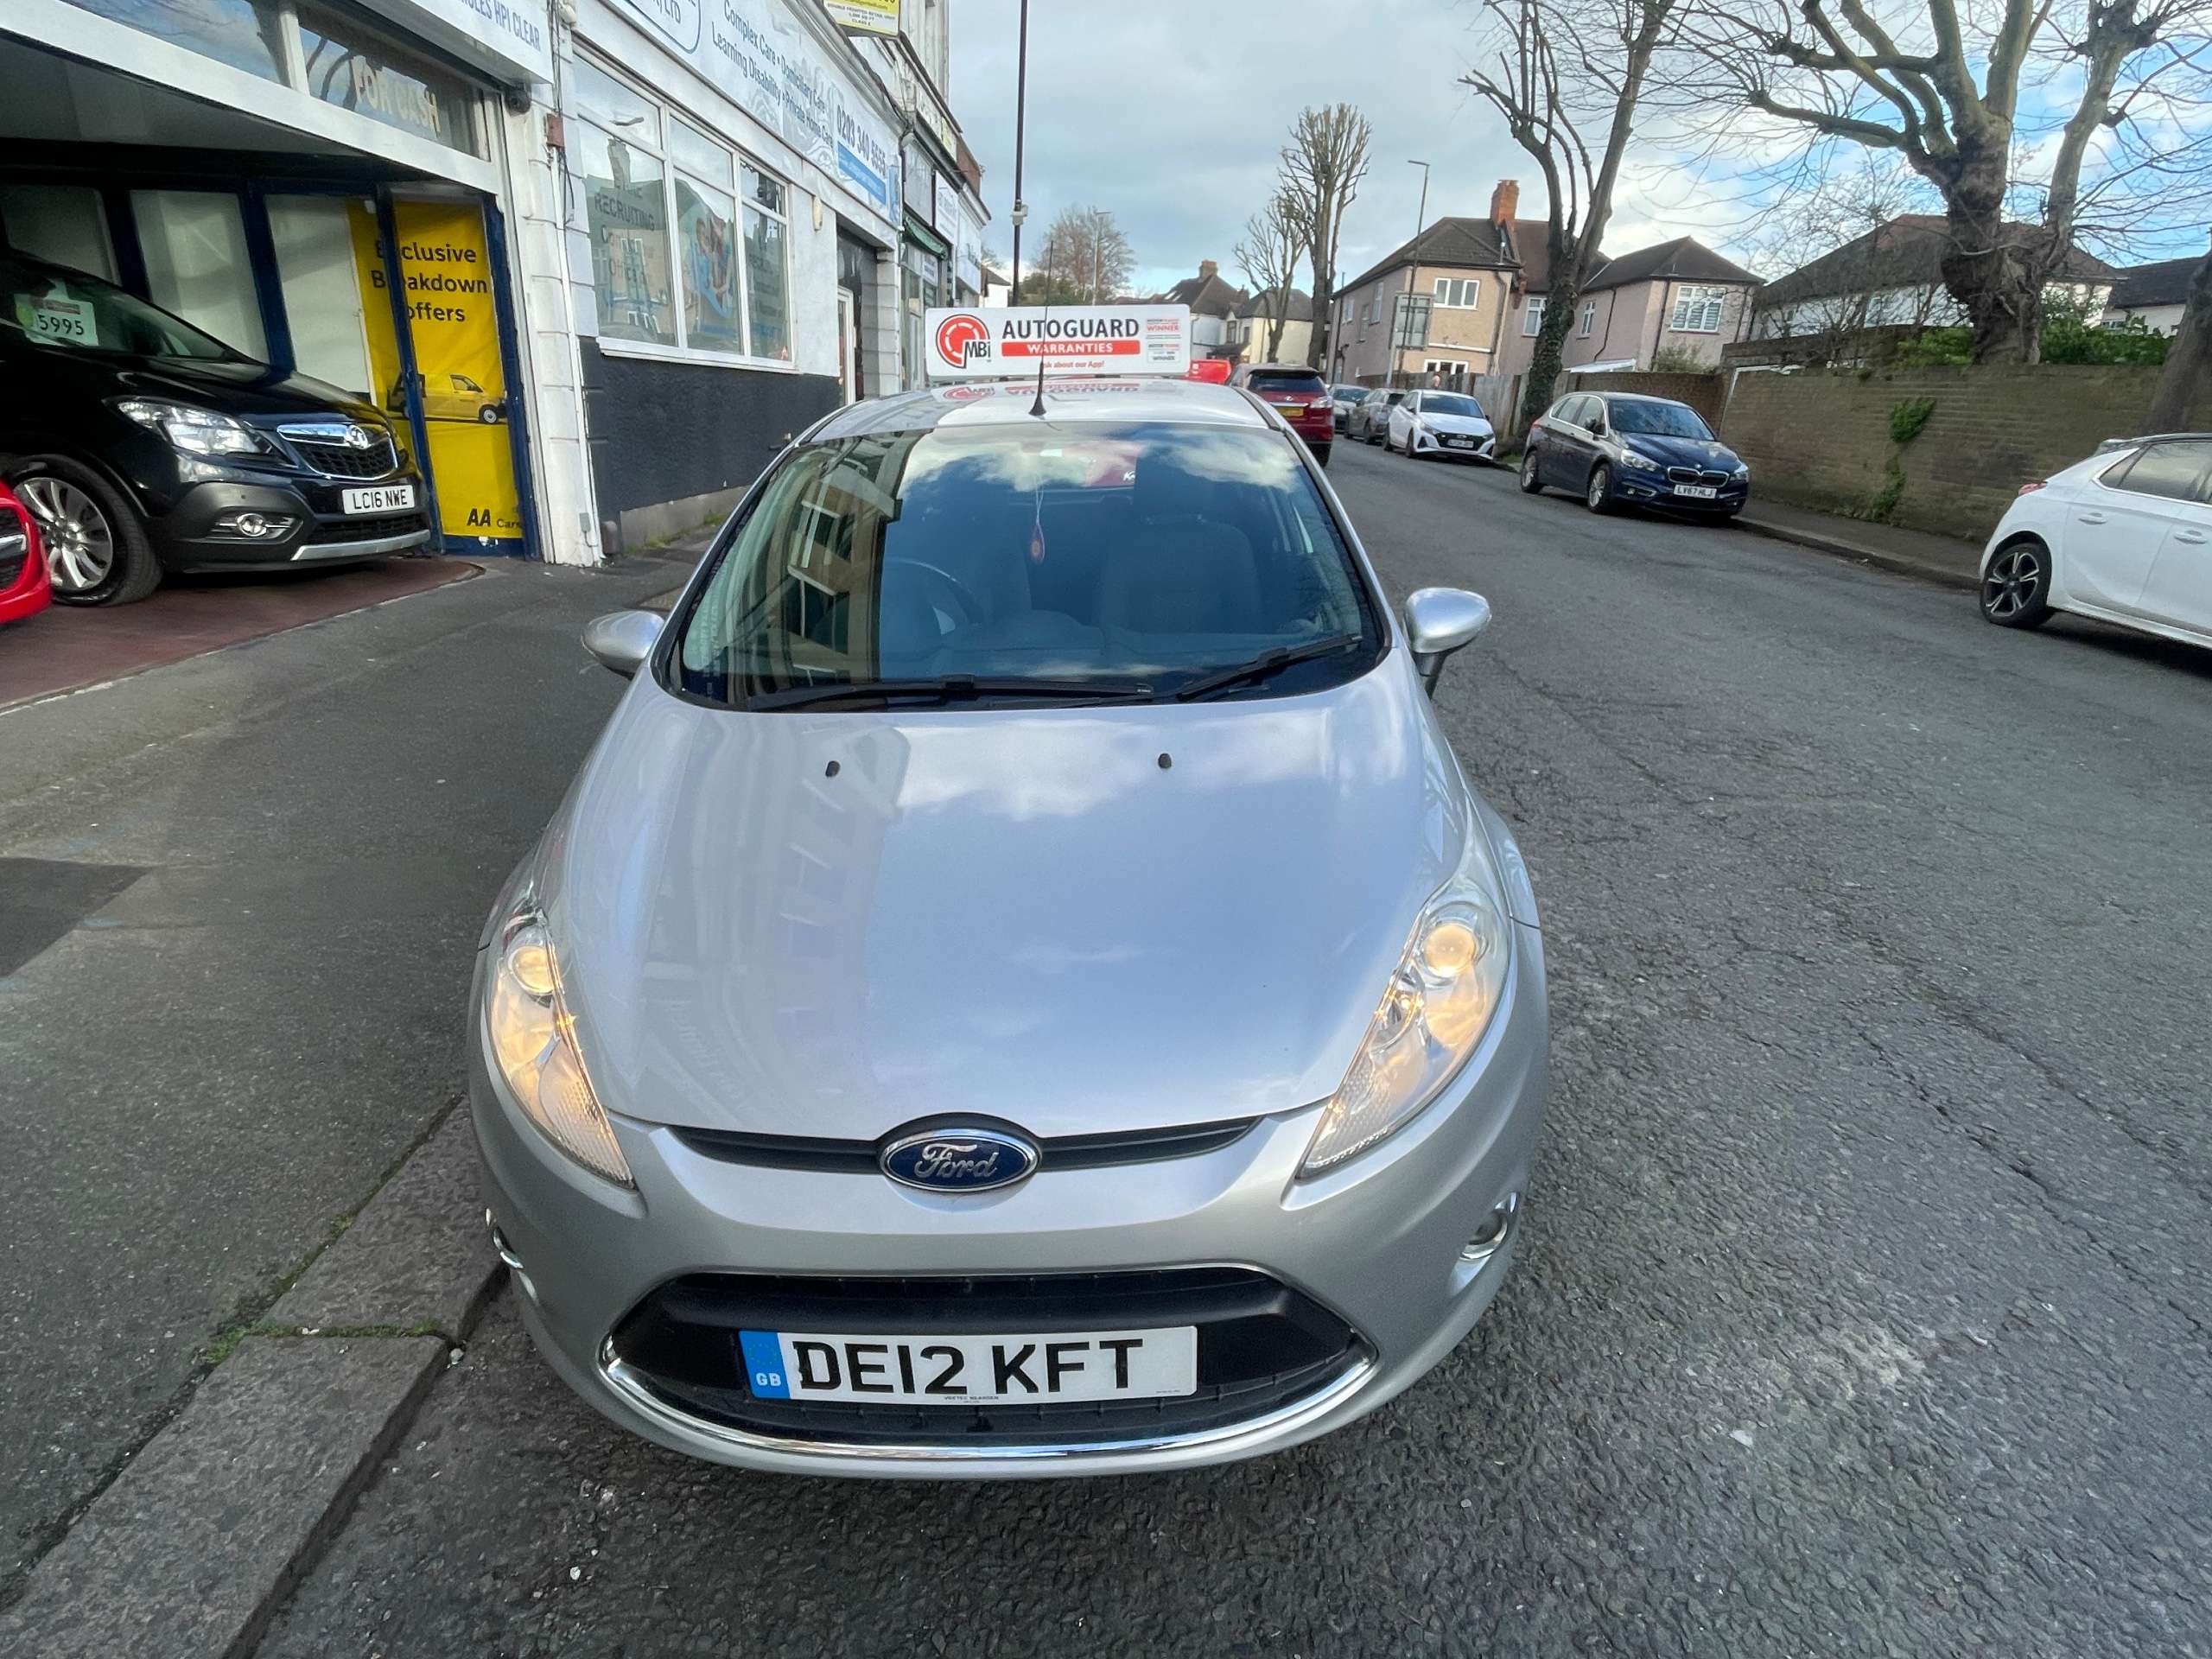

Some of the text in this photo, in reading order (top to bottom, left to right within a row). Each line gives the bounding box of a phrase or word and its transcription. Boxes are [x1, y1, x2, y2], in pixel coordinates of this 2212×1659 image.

[495, 2, 512, 33] HPI
[512, 11, 541, 52] CLEAR
[724, 0, 759, 49] Complex
[760, 35, 776, 66] Care
[712, 21, 748, 79] Learning
[748, 57, 782, 106] Disability
[352, 54, 441, 136] FOR CASH
[836, 104, 855, 148] 0203
[594, 192, 655, 231] RECRUITING
[376, 239, 477, 264] Eclusive
[371, 269, 488, 294] Bakdown
[37, 314, 85, 336] 5995
[1002, 318, 1140, 340] AUTOGUARD
[1147, 323, 1179, 332] WINNER
[965, 340, 991, 359] MBi
[1027, 342, 1114, 354] WARRANTIES
[353, 489, 408, 510] LC16 NWE
[466, 507, 491, 527] AA
[914, 1142, 999, 1179] Ford
[791, 1338, 1144, 1395] DE12 KFT
[755, 1371, 782, 1388] GB
